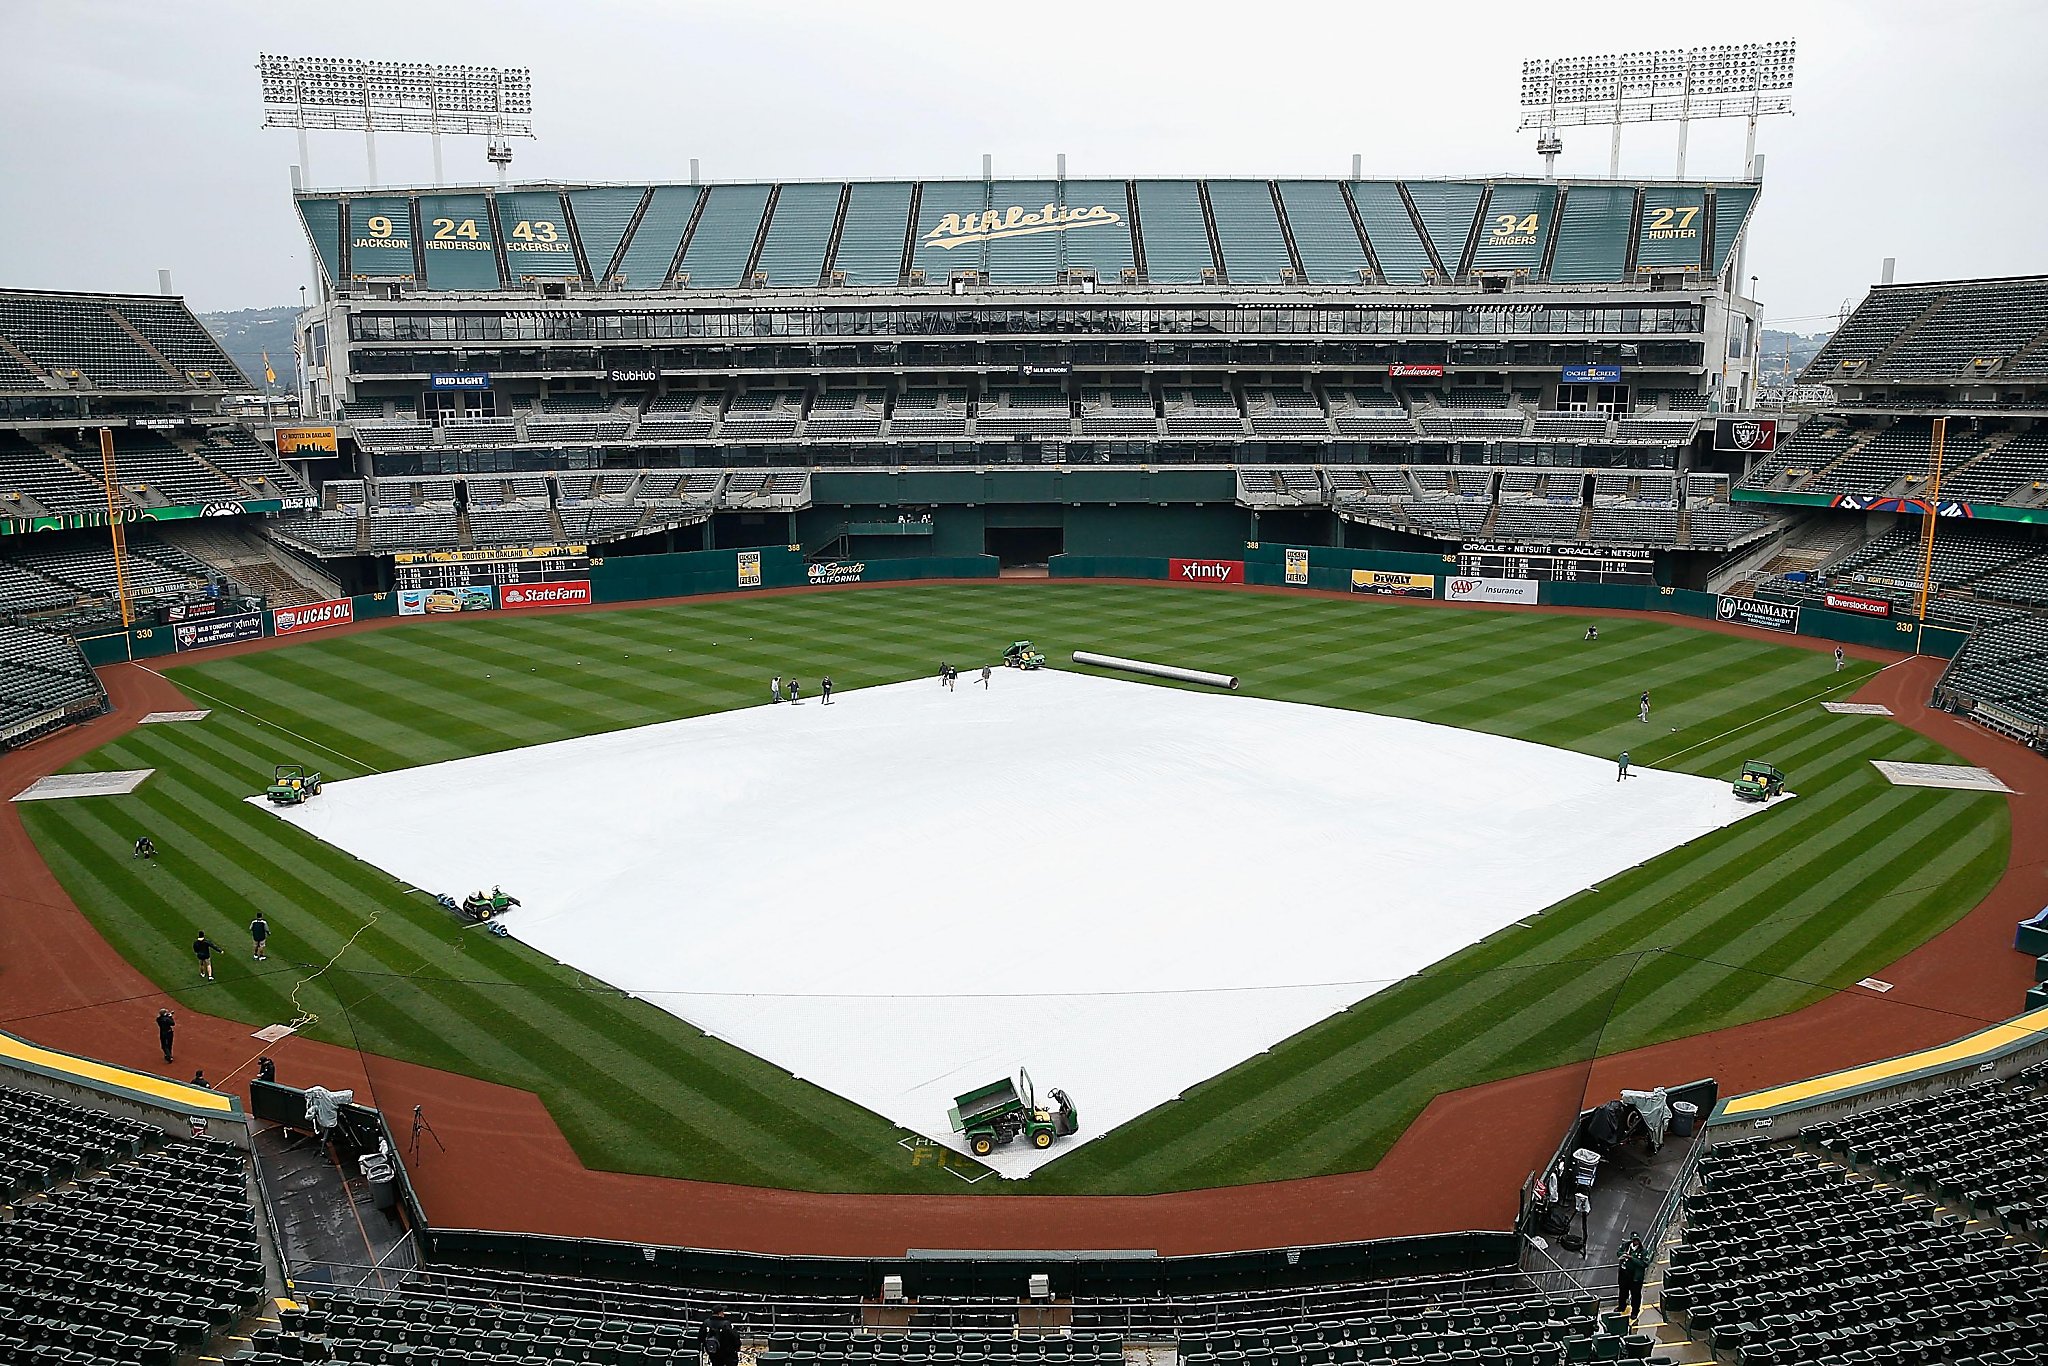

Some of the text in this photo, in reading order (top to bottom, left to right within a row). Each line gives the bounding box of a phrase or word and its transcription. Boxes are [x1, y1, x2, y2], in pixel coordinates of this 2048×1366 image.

[921, 203, 1120, 243] Athletics
[1650, 206, 1700, 229] 27
[368, 216, 392, 238] 9
[432, 218, 480, 240] 24
[1492, 213, 1539, 236] 34
[512, 220, 558, 242] 43
[1648, 229, 1697, 240] HUNTER
[353, 238, 408, 248] JACKSON
[425, 240, 491, 251] HENDERSON
[1488, 236, 1537, 246] FINGERS
[506, 242, 570, 252] ECKERSLEY
[611, 370, 656, 381] StubHub
[1391, 365, 1441, 376] Budweiser
[435, 377, 484, 385] BUD LIGHT
[205, 501, 241, 517] OAKLAND
[281, 497, 318, 510] 10:52 AM
[462, 552, 485, 560] ROOTED
[495, 550, 523, 558] OAKLAND
[1462, 543, 1506, 552] ORACLE
[1513, 545, 1552, 554] NETSUITE
[1557, 547, 1603, 556] ORACLE
[1611, 549, 1650, 558] NETSUITE
[589, 558, 604, 566] 362
[1442, 554, 1457, 563] 362
[825, 562, 865, 577] Sports
[1182, 562, 1232, 581] xfinity
[740, 576, 759, 584] FIELD
[809, 575, 861, 585] CALIFORNIA
[1867, 576, 1881, 584] RIGHT
[1881, 577, 1894, 585] FIELD
[129, 589, 141, 597] LEFT
[141, 587, 154, 595] FIELD
[1452, 580, 1524, 595] AAA Insurance
[1660, 586, 1676, 595] 367
[373, 592, 388, 601] 367
[1834, 599, 1886, 613] overstock.com
[296, 603, 350, 625] LUCAS OIL
[197, 621, 232, 633] MLB TONIGHT
[235, 617, 260, 630] xfinity
[1896, 622, 1913, 632] 330
[136, 629, 153, 639] 330
[178, 626, 196, 635] MLB
[197, 636, 208, 644] MLB
[208, 632, 235, 642] NETWORK
